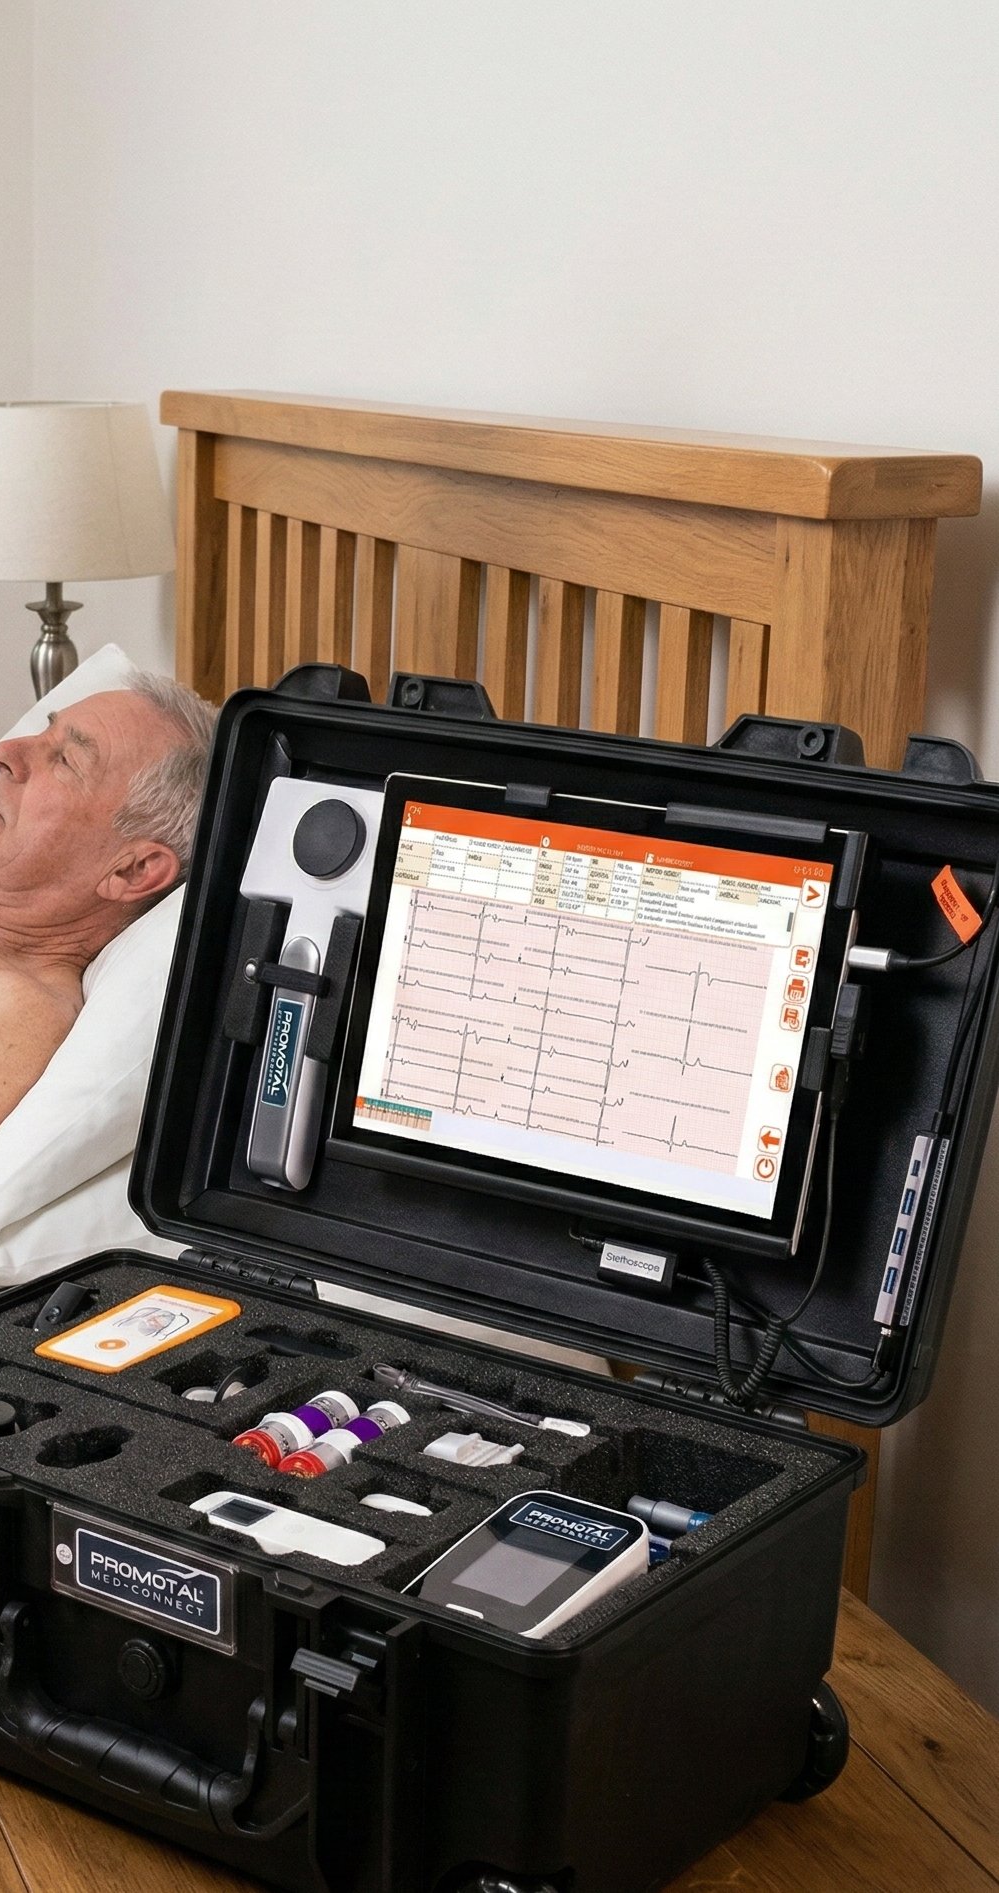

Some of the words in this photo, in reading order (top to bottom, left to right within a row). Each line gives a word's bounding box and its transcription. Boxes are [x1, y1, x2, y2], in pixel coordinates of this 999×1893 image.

[528, 1510, 611, 1541] PROMOTAL
[91, 1551, 205, 1605] PROMOTAL
[91, 1569, 205, 1617] MED-CONNECT
